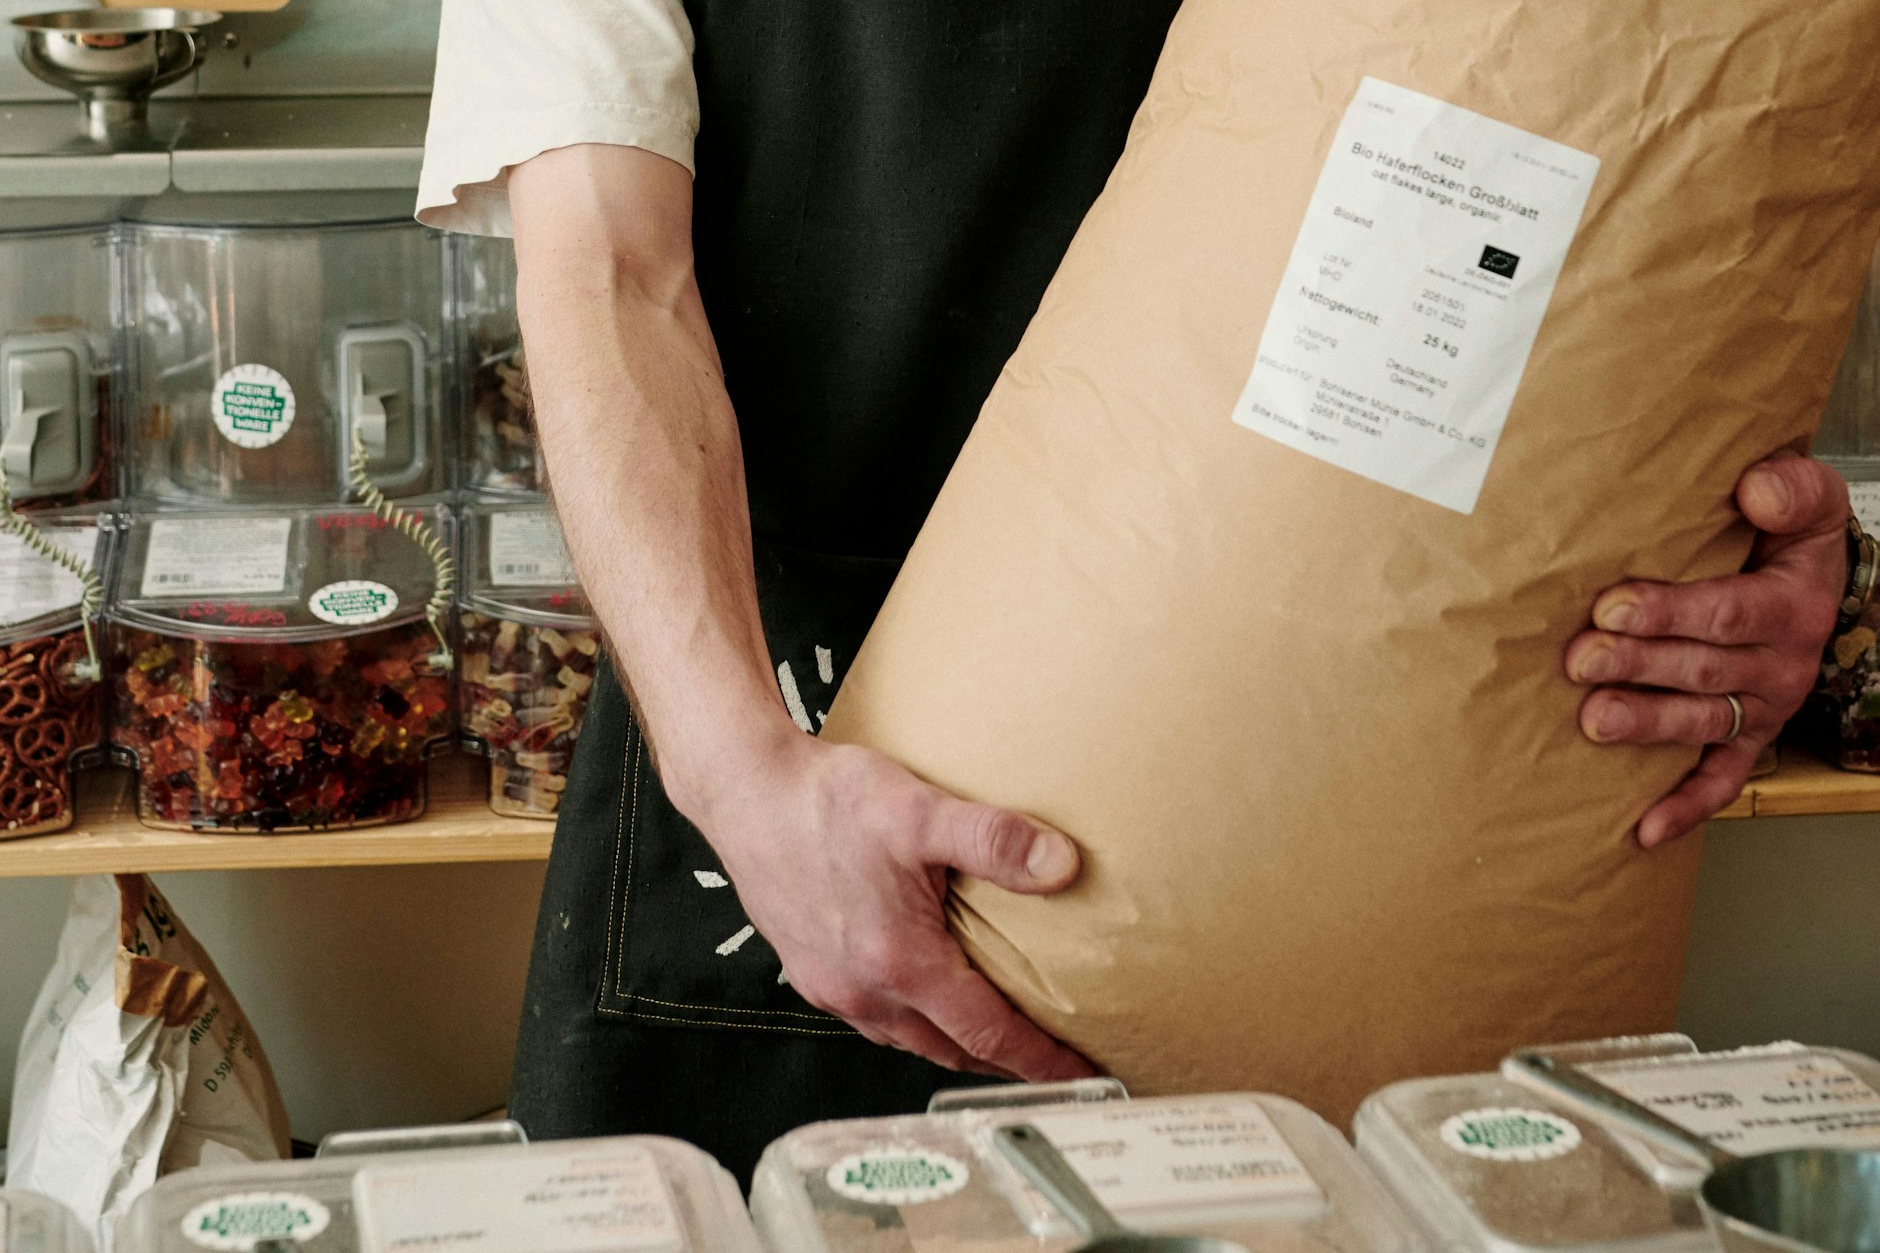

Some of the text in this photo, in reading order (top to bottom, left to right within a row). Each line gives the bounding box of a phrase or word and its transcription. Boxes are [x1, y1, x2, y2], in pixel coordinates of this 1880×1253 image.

[1351, 141, 1540, 221] Bio Haferflocken Großblatt
[1372, 169, 1389, 182] oat
[1391, 174, 1423, 194] flakes
[1333, 206, 1375, 229] Bioland
[1423, 333, 1460, 358] 25 kg
[1386, 357, 1448, 389] Deutschland
[238, 385, 273, 397] KEINE
[1389, 372, 1435, 399] Germany
[225, 394, 283, 409] KONVEN-
[226, 405, 281, 420] TIONELLE
[236, 419, 269, 432] WARE
[1437, 423, 1446, 435] &
